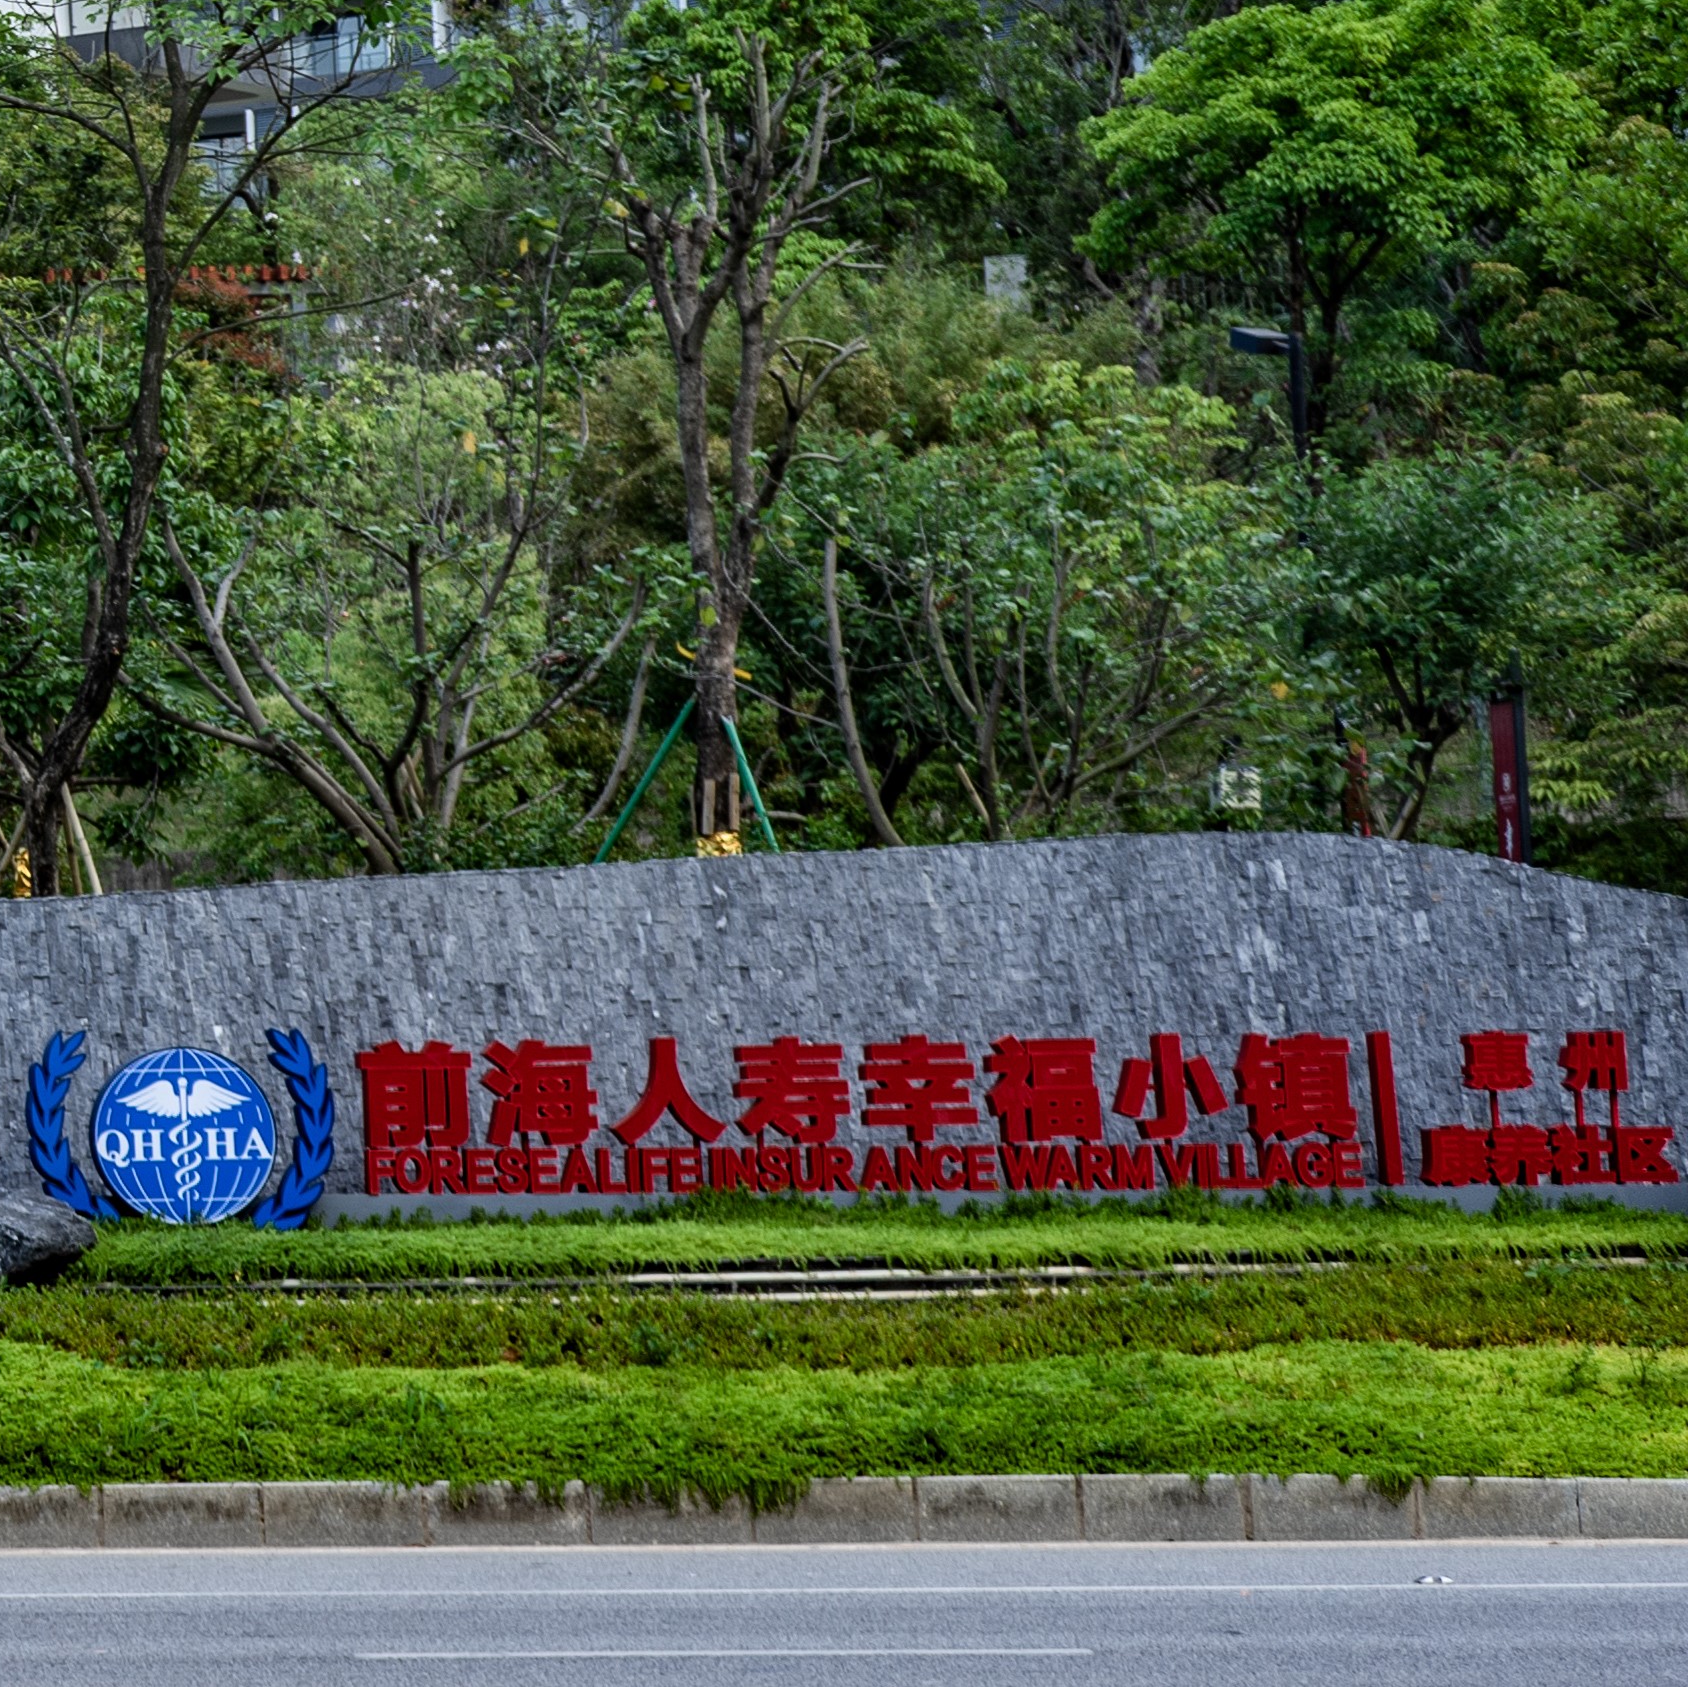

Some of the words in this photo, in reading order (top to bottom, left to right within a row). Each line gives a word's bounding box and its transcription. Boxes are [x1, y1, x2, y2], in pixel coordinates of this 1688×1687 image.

[355, 1032, 1358, 1148] 前海人寿幸福小镇
[1459, 1029, 1630, 1092] 惠州
[997, 1142, 1156, 1192] WARM
[1152, 1141, 1366, 1190] VILLAGE
[1419, 1123, 1680, 1187] 康养社区
